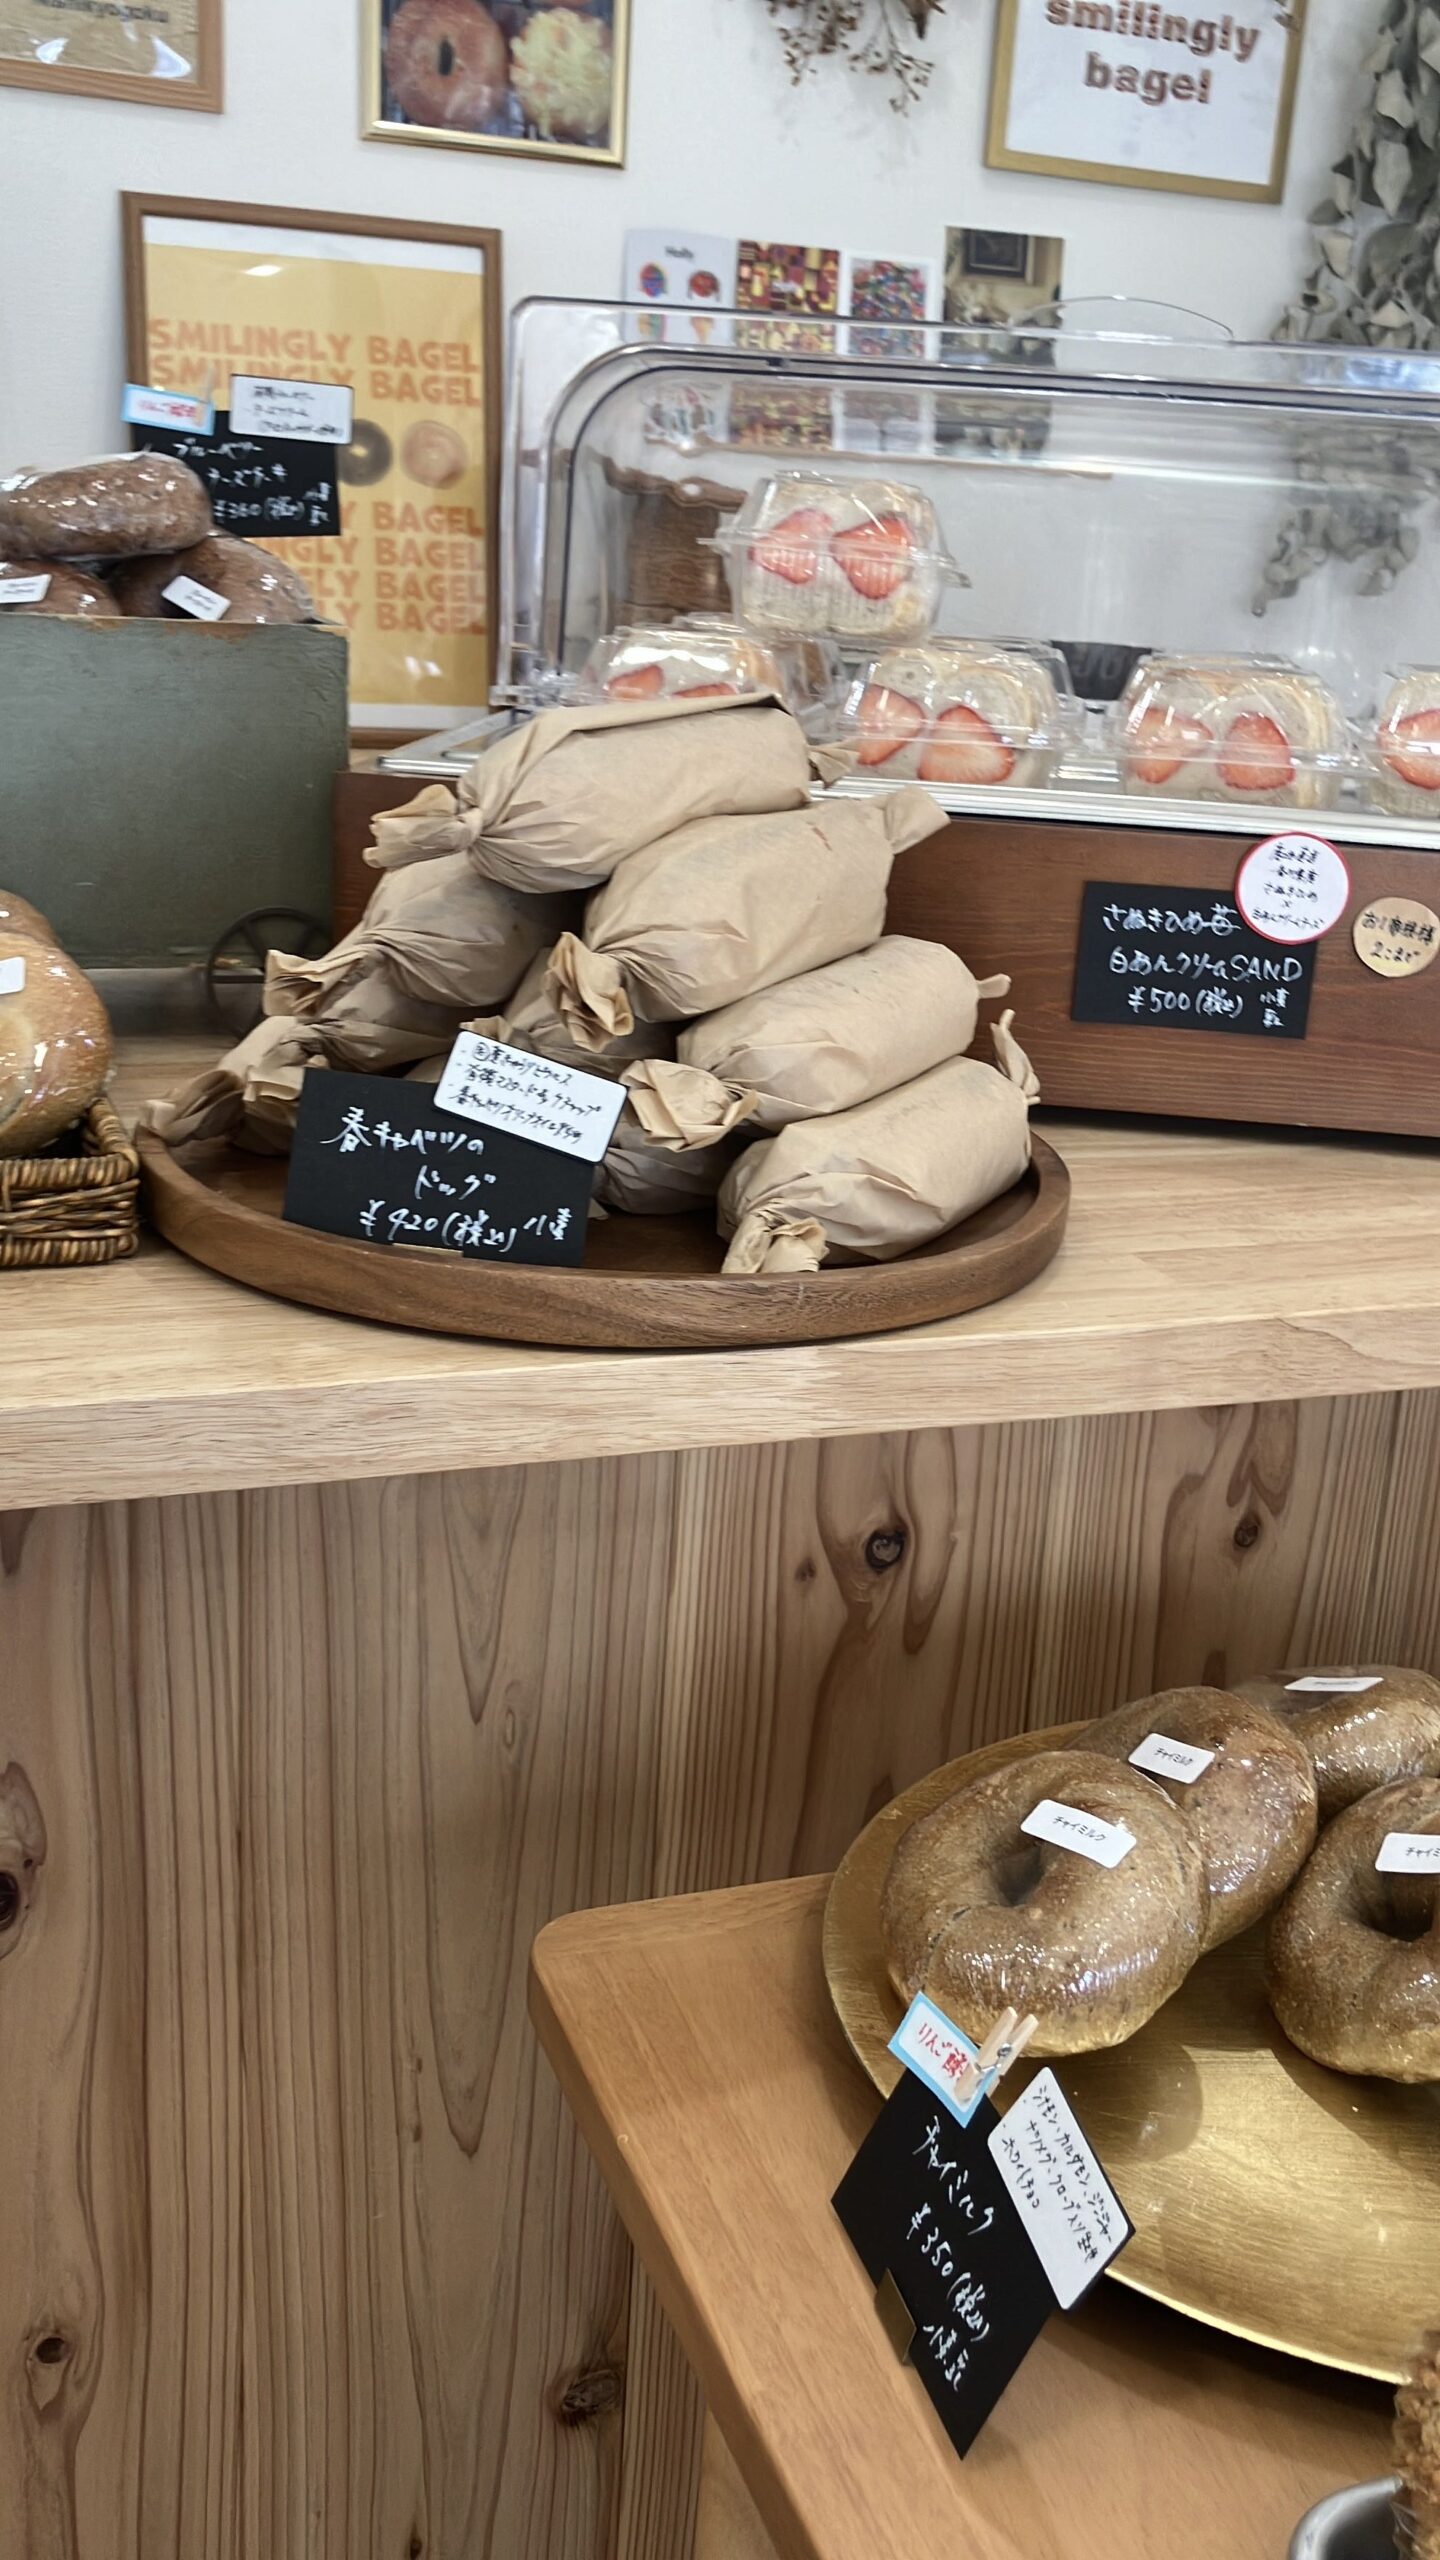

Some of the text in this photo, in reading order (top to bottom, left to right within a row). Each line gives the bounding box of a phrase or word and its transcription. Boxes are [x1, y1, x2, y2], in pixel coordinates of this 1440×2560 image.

[1045, 0, 1261, 62] smilingly
[1083, 50, 1213, 106] bagel
[149, 318, 480, 372] SMILINGLY BAGEL
[370, 370, 481, 407] BAGEL
[373, 501, 485, 538] BAGEL
[374, 536, 485, 571] BAGEL
[375, 571, 486, 604] BAGEL
[376, 602, 486, 636] BAGEL
[320, 1106, 485, 1155] 春キャベツの
[415, 1164, 497, 1200] ドッグ
[1053, 1816, 1107, 1841] チャイミルク
[912, 2115, 995, 2236] チャイミルク
